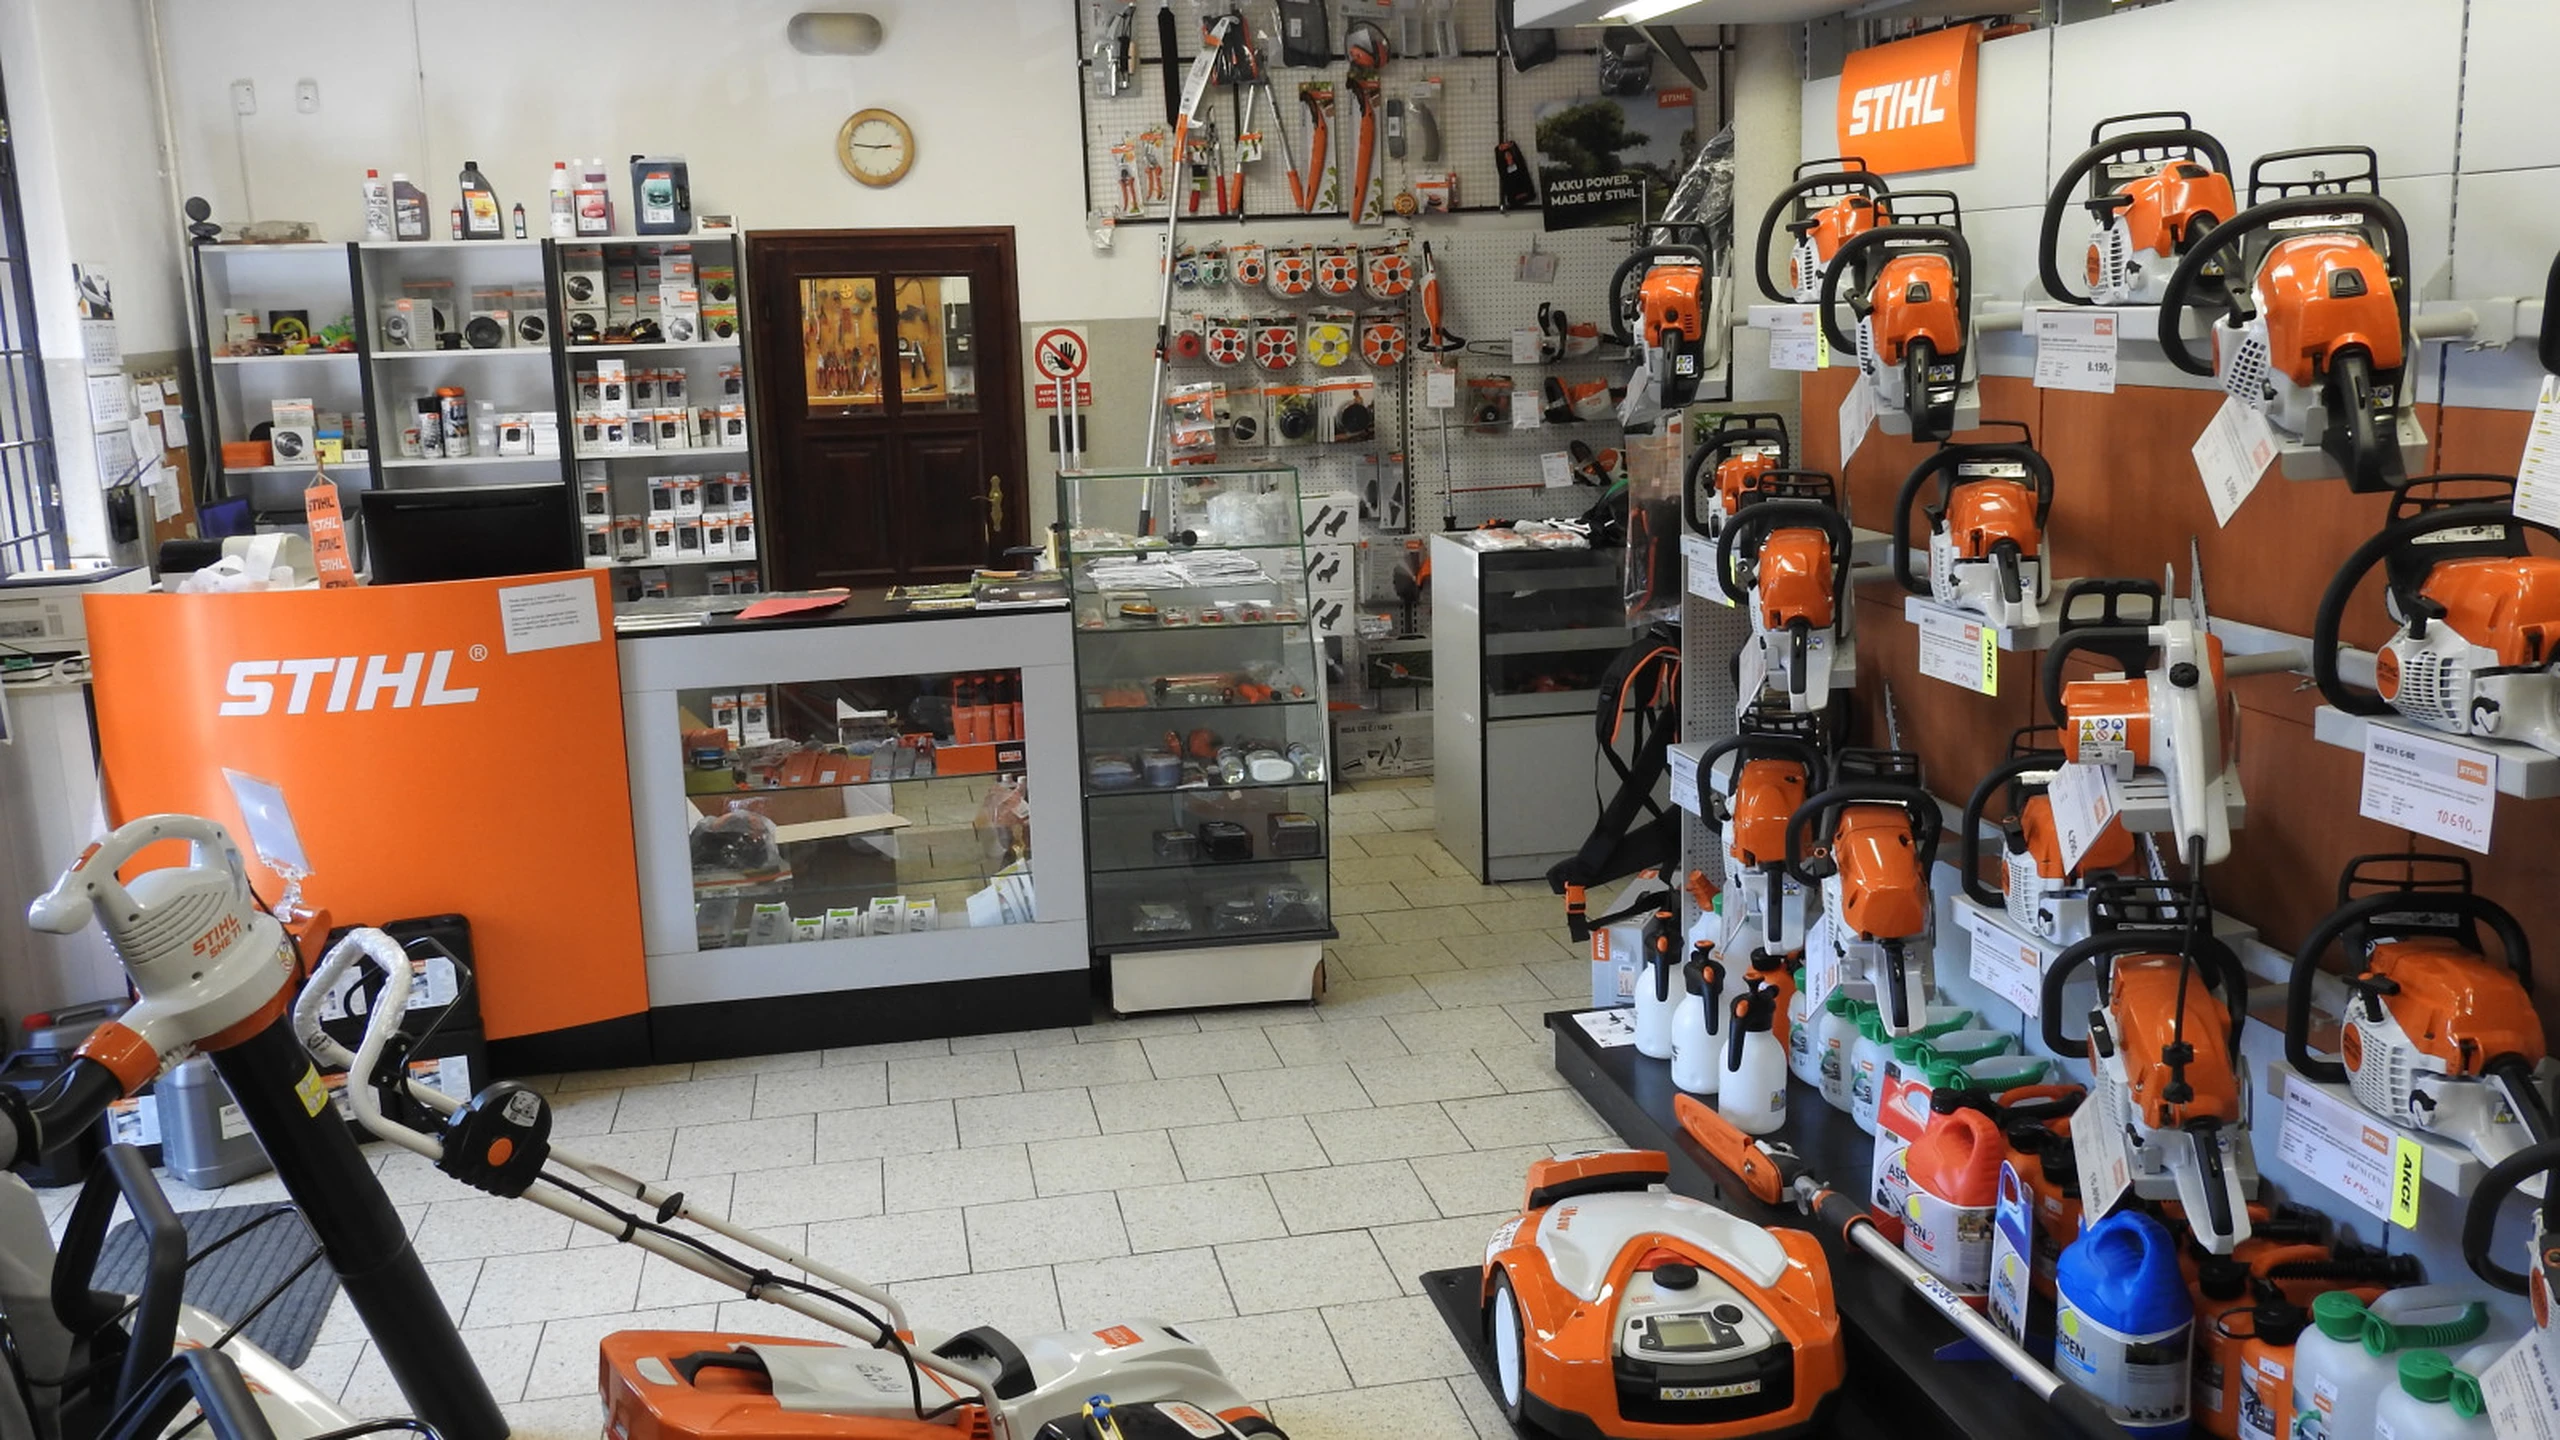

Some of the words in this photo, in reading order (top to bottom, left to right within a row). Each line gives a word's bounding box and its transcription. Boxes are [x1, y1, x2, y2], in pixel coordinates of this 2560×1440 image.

[1660, 93, 1690, 105] STIHL
[1849, 74, 1944, 136] STIHL
[1550, 179, 1584, 192] AKKU
[1586, 175, 1633, 188] POWER.
[1551, 193, 1586, 206] MADE
[1588, 191, 1604, 203] BY
[1605, 189, 1641, 201] STIHL.
[308, 495, 335, 512] STIHL
[313, 516, 339, 532] STIHL
[320, 558, 346, 572] STIHL
[219, 649, 480, 717] STIHL
[2459, 764, 2486, 780] STIHL
[192, 913, 240, 957] STIHL
[209, 938, 232, 960] SHE
[1597, 934, 1608, 959] STIHL
[2400, 1152, 2413, 1213] AKCE
